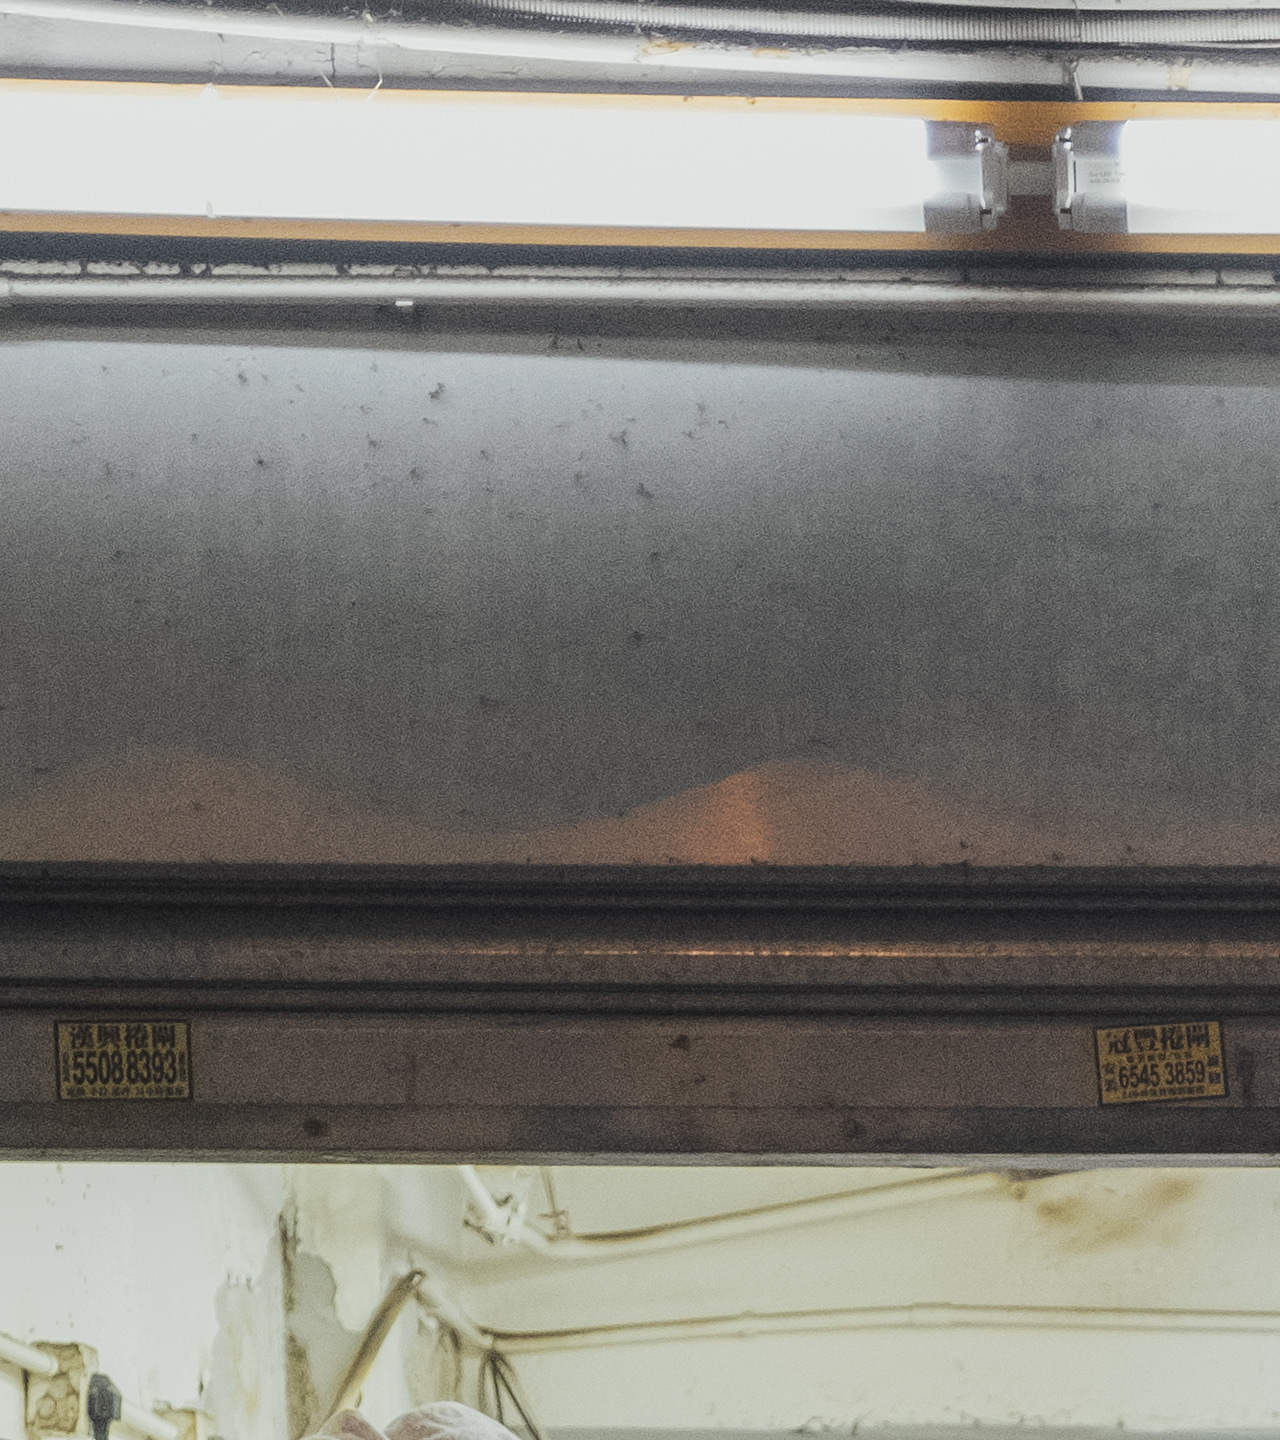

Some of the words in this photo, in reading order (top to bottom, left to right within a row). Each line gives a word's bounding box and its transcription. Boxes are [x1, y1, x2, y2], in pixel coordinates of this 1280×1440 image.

[73, 1050, 123, 1084] 5508
[126, 1049, 177, 1084] 8393
[1118, 1063, 1160, 1088] 6545
[1164, 1060, 1206, 1085] 3859
